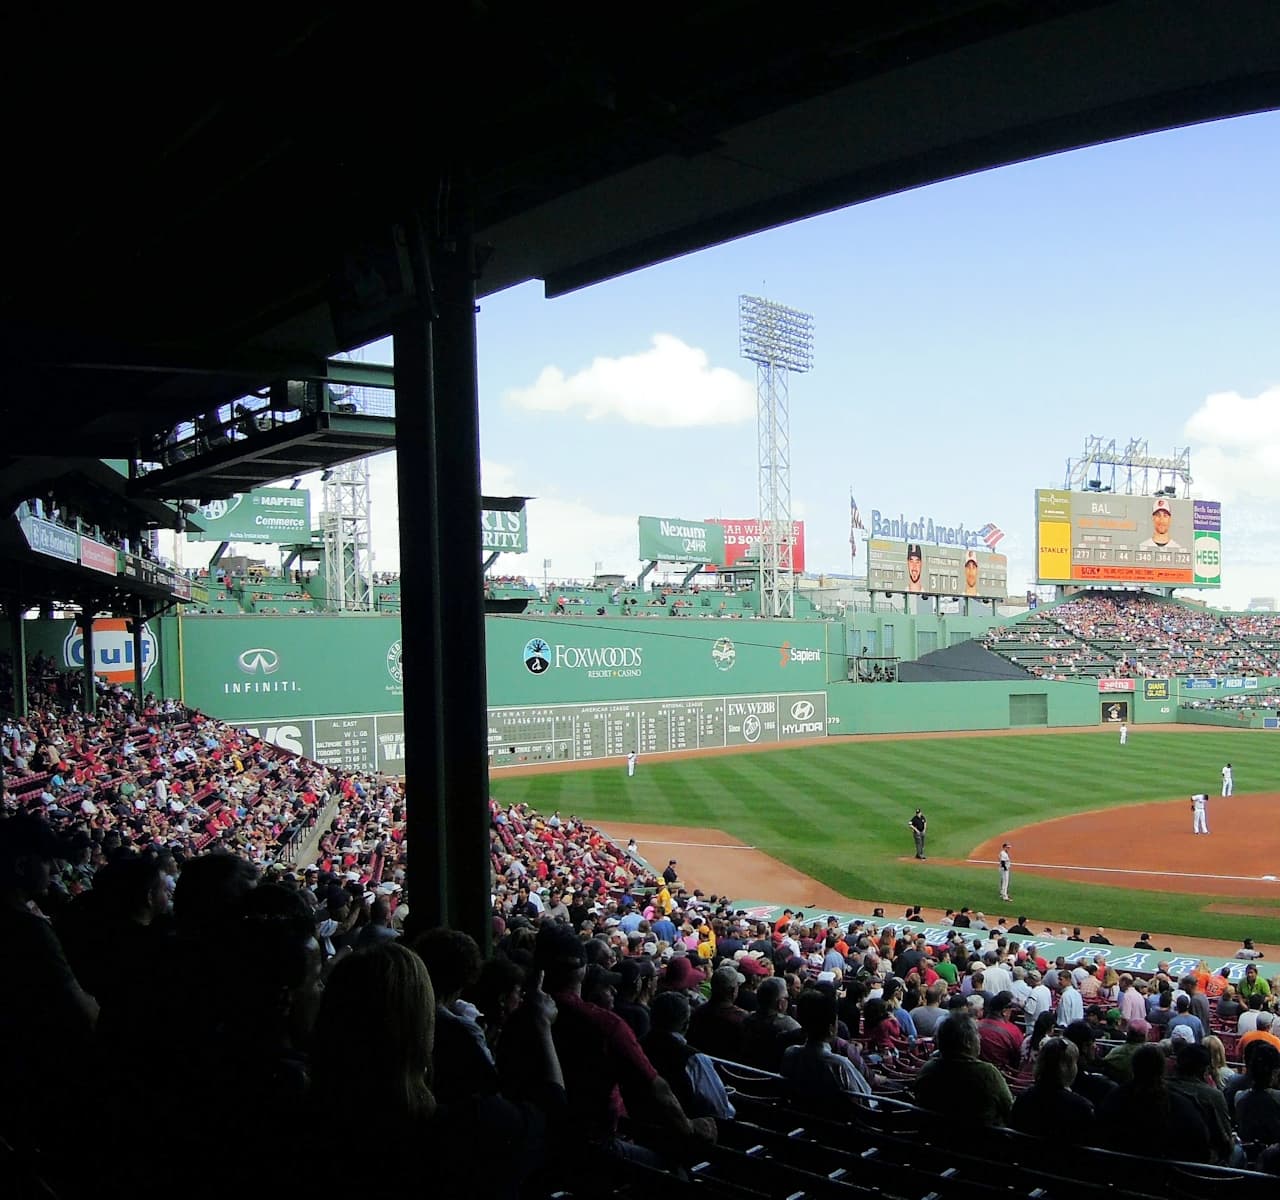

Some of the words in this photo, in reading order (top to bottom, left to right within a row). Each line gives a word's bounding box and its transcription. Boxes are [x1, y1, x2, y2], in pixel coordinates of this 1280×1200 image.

[261, 496, 305, 507] MAPFRE
[1091, 503, 1111, 514] BAL
[255, 515, 305, 527] Commerce
[660, 520, 706, 539] Nexium
[871, 510, 908, 539] Bank
[909, 517, 925, 540] of
[927, 518, 978, 547] America
[1196, 550, 1219, 565] HESS
[555, 645, 642, 668] FOXWOODS
[790, 648, 821, 662] Sapient
[588, 670, 612, 678] RESORT
[617, 669, 642, 677] CASINO
[224, 681, 297, 694] INFINITI
[1103, 680, 1129, 690] aetna
[747, 701, 776, 714] WEBB
[782, 721, 824, 735] HYUNDAI
